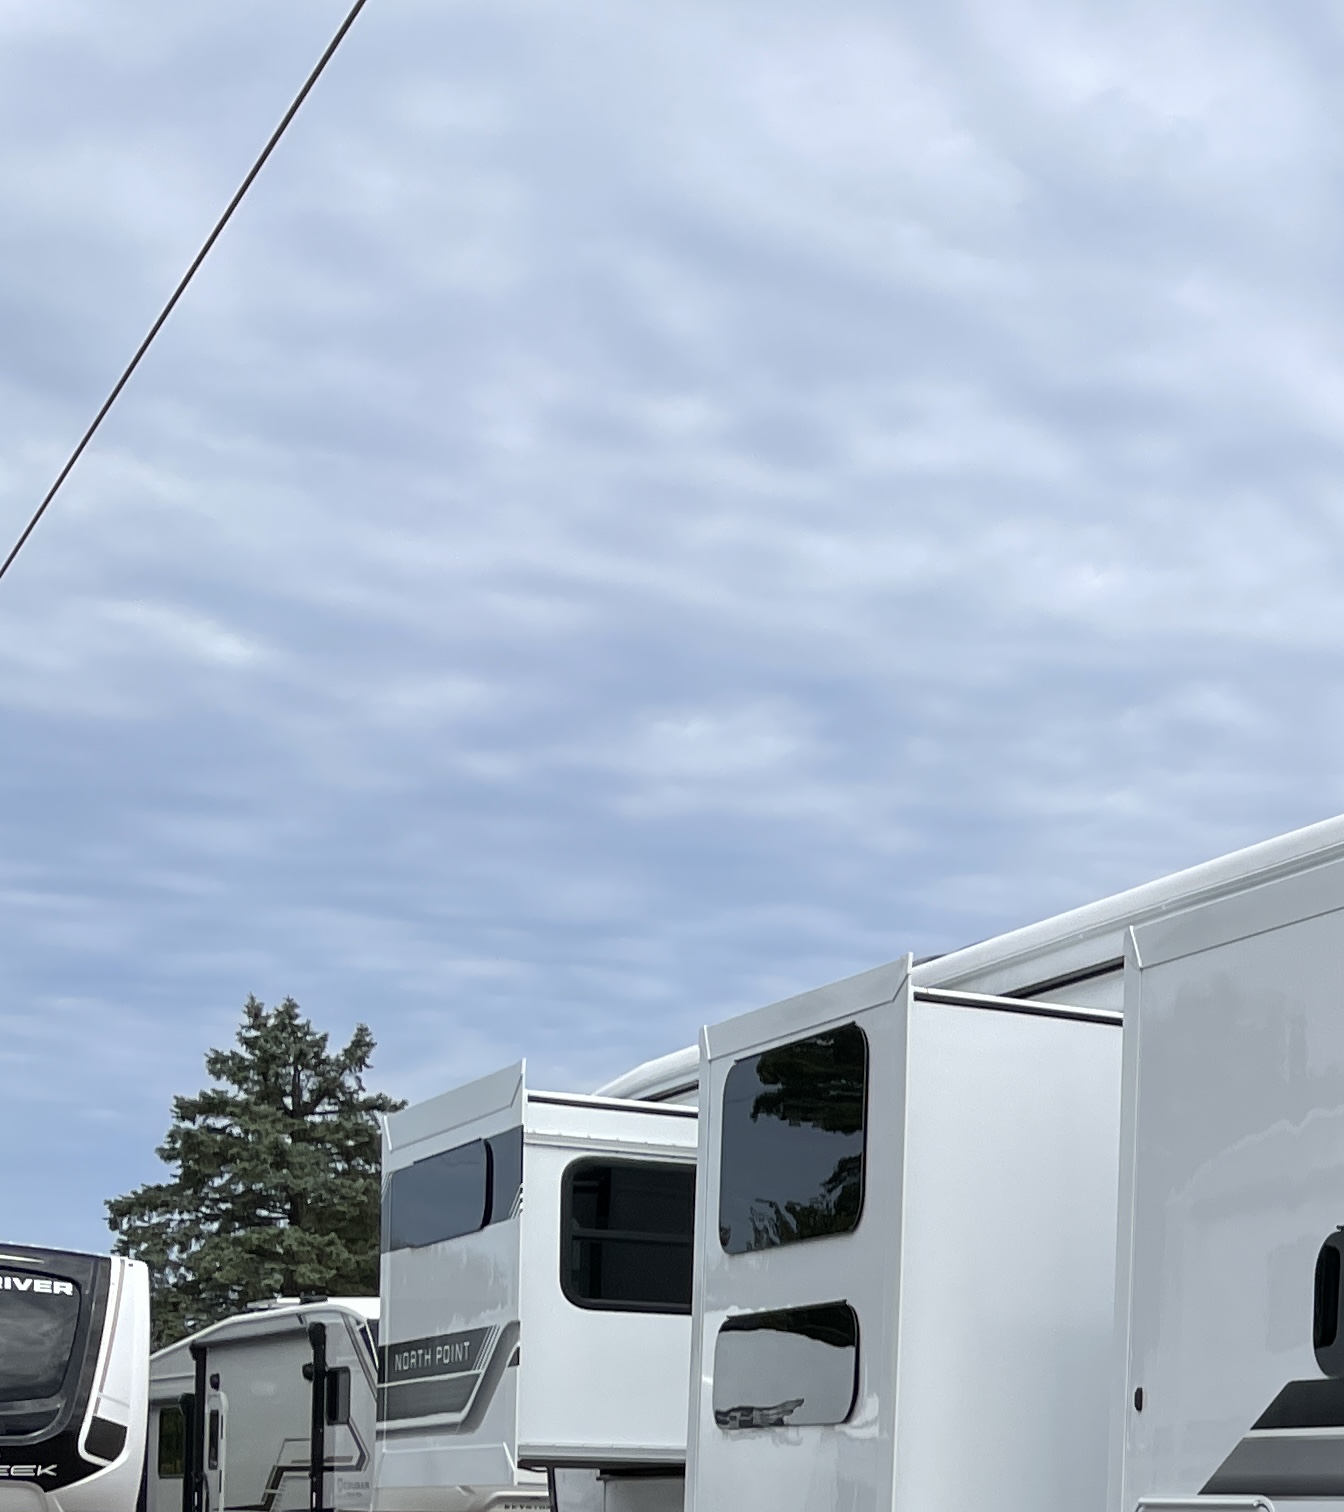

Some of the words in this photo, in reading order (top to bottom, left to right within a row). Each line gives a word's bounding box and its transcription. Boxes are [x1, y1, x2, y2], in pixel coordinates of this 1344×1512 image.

[0, 1276, 74, 1296] IVER
[394, 1347, 432, 1372] NORTH
[435, 1341, 470, 1365] POINT
